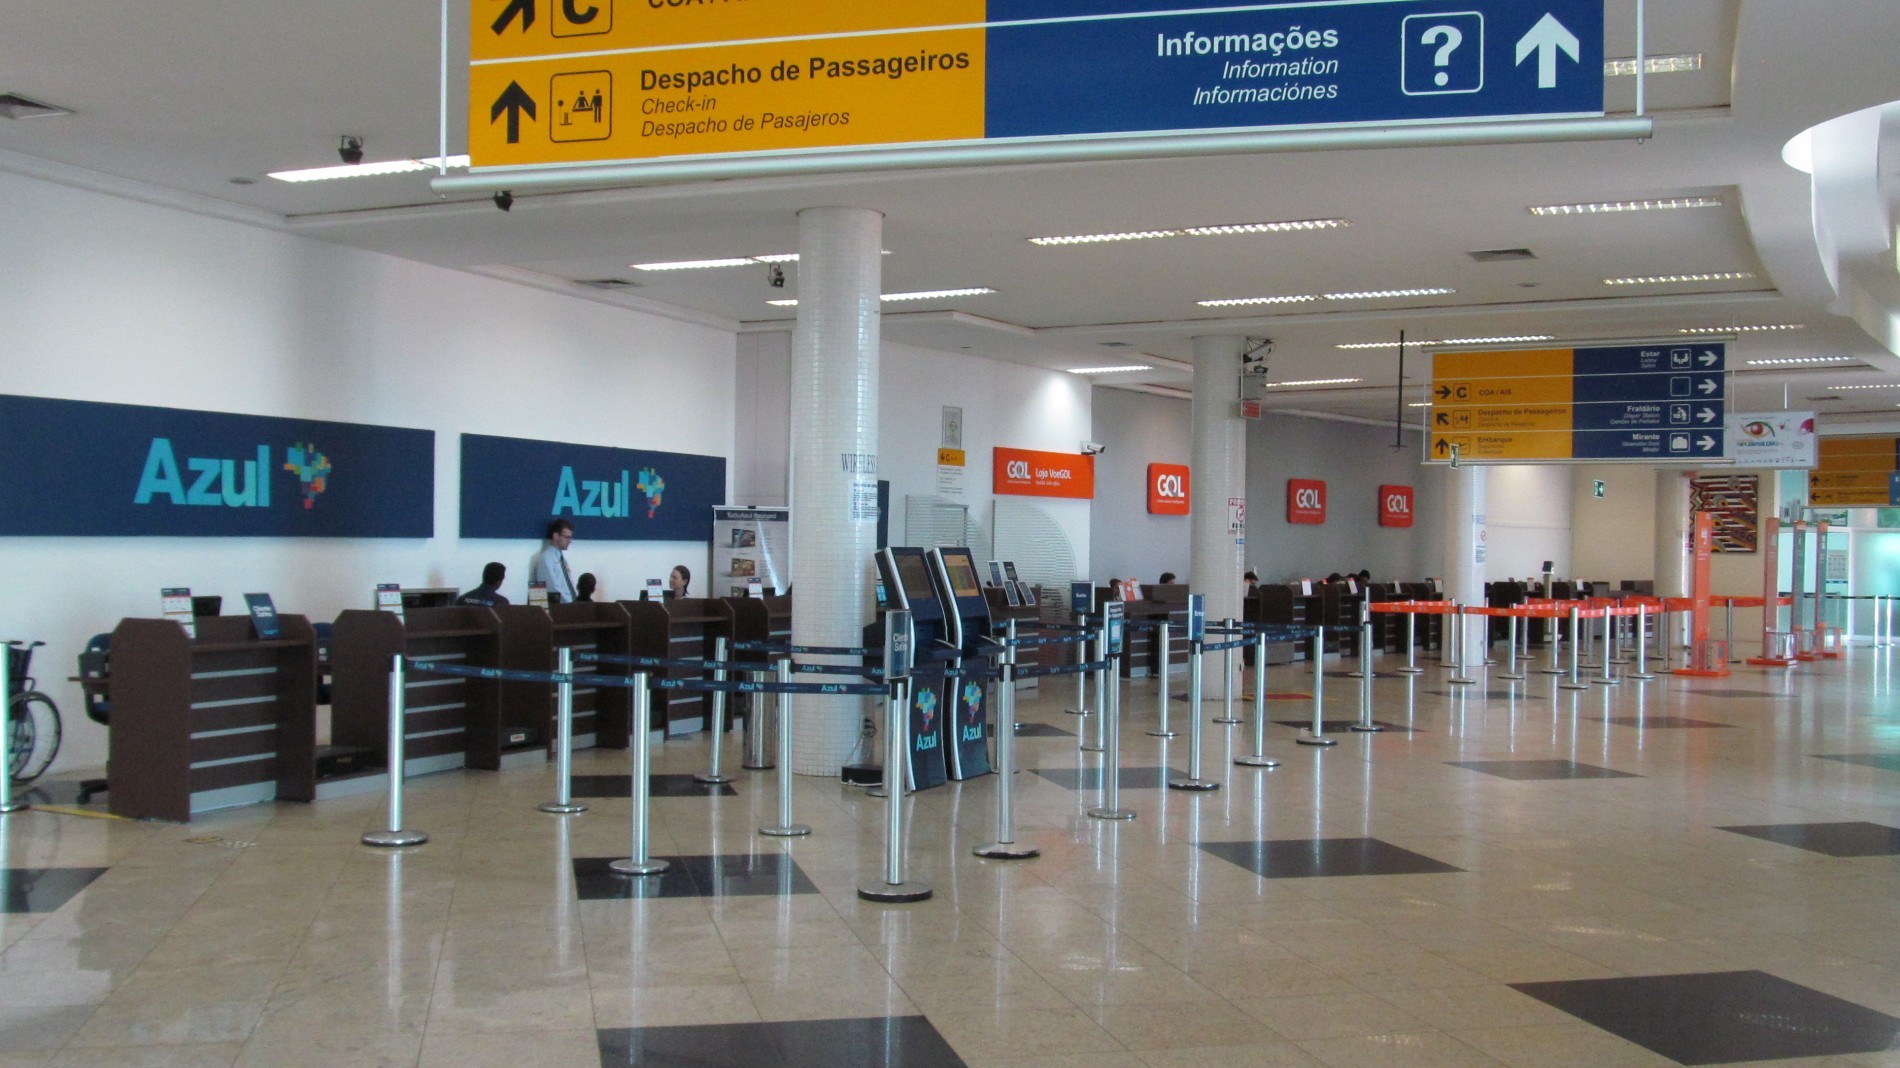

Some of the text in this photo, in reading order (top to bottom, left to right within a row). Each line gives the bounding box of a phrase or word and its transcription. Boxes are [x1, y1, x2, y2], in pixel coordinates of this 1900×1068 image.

[1157, 25, 1339, 57] Informações
[640, 50, 970, 92] Despacho de Passageiros
[1222, 58, 1339, 80] Information
[1193, 81, 1339, 105] Informaciónes
[641, 96, 716, 115] Check-in
[641, 109, 850, 138] Despacho de Pasajeros
[1478, 436, 1513, 444] Embarque
[134, 437, 271, 508] Azul
[1007, 460, 1031, 479] GOL
[1035, 467, 1048, 481] Loja
[551, 465, 629, 518] Azul
[1157, 474, 1185, 498] GOL
[1296, 488, 1321, 509] GOL
[1387, 494, 1409, 513] GOL
[802, 664, 815, 672] Azul
[661, 679, 676, 688] Azul
[739, 682, 754, 691] Azul
[821, 683, 838, 692] Azul
[916, 731, 937, 751] Azul
[962, 722, 982, 742] Azul
